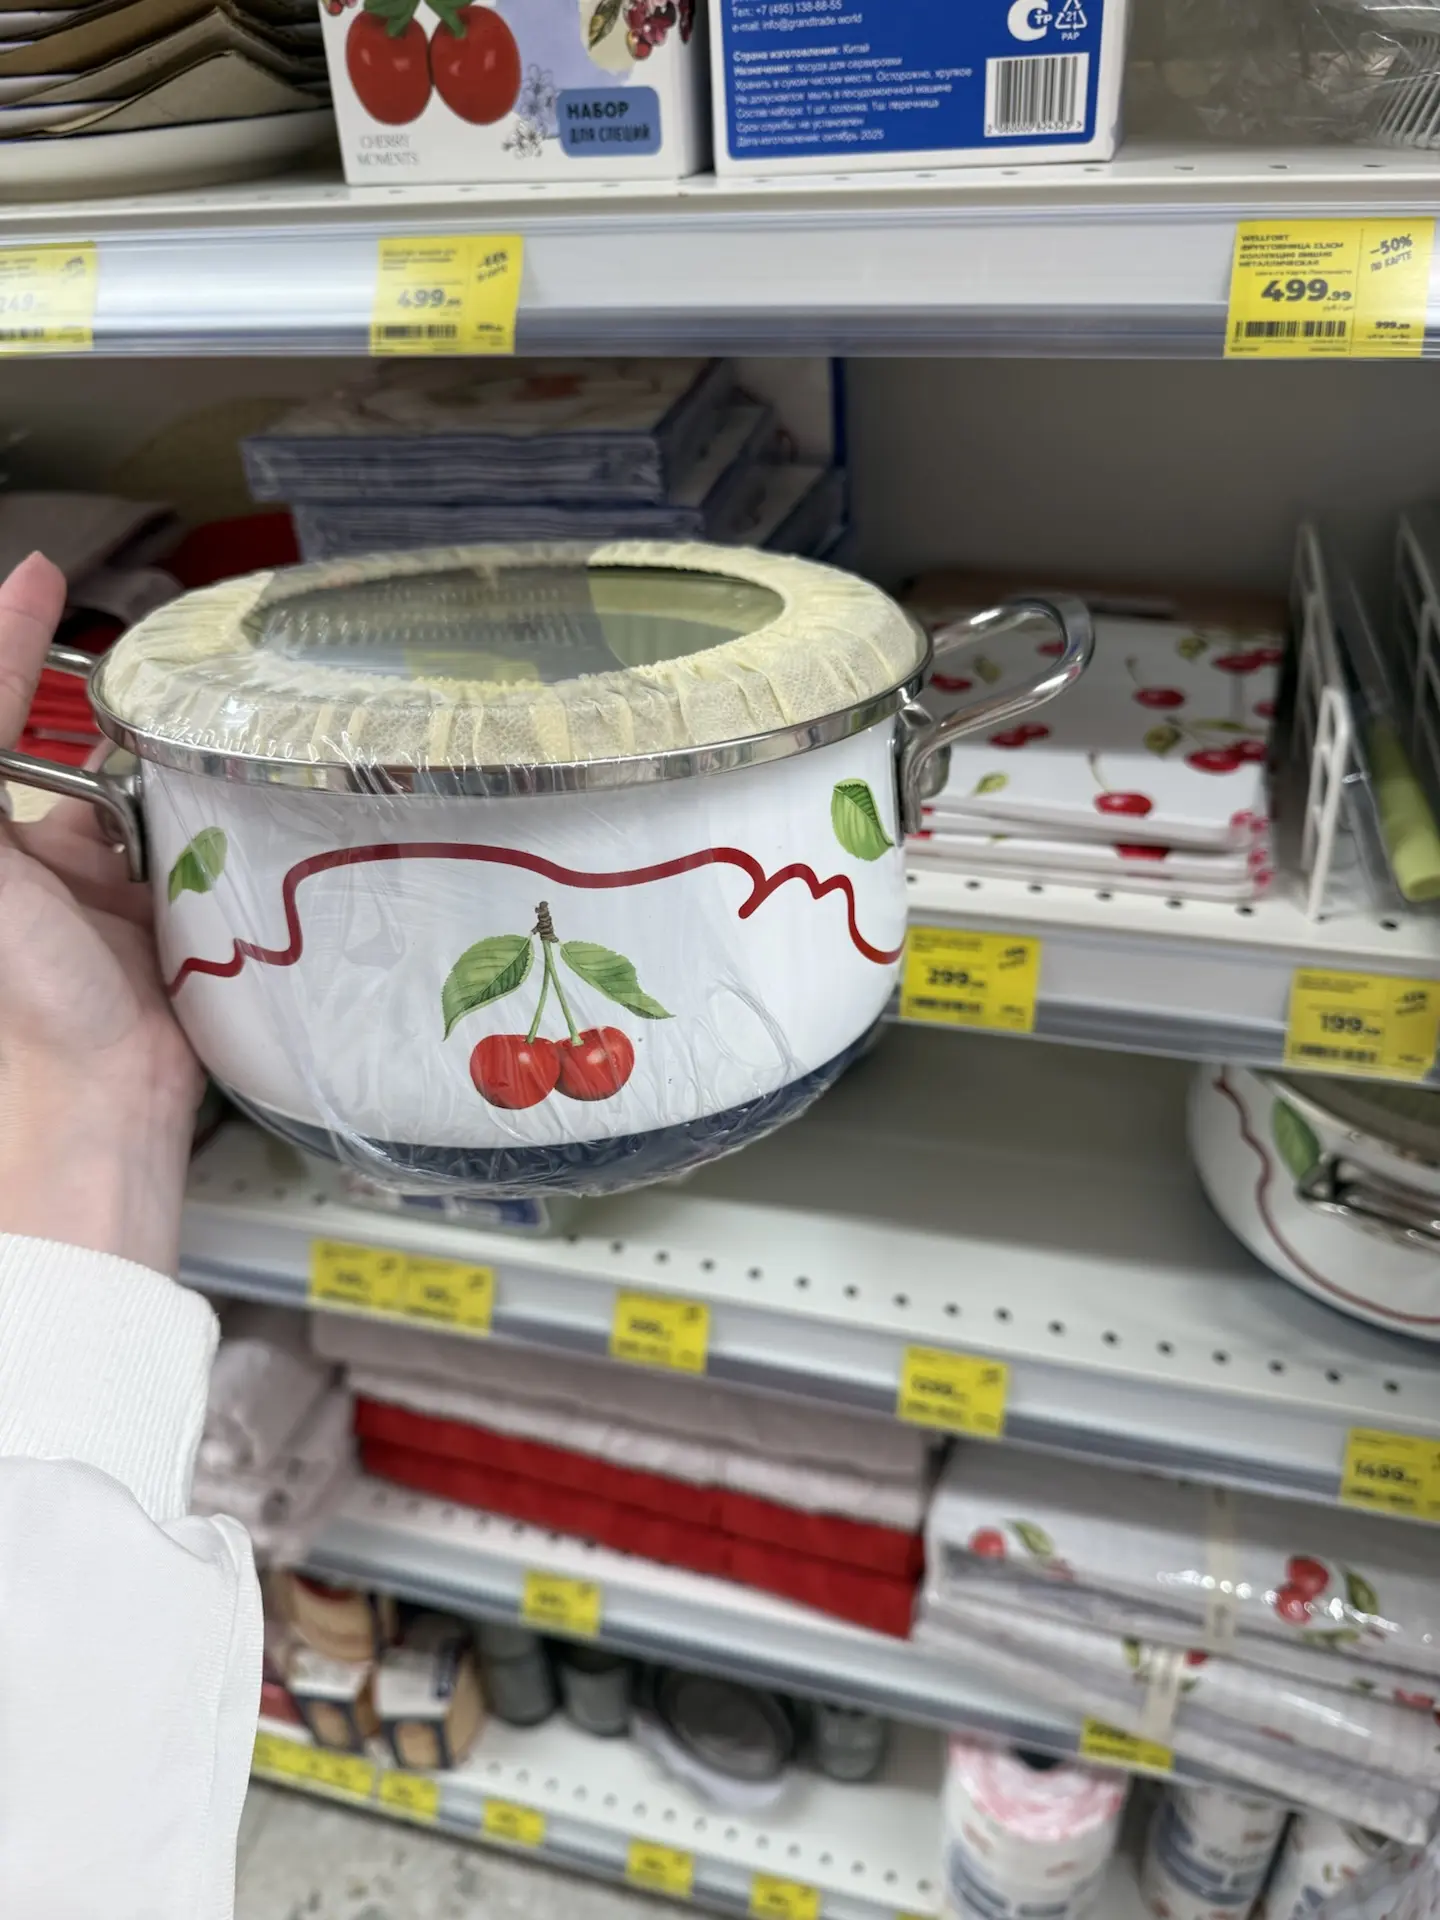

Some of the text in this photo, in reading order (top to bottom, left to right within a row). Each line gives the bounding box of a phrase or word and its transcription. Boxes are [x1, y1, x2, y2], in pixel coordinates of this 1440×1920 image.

[1065, 11, 1078, 22] 21
[1061, 31, 1081, 41] PAP
[565, 101, 631, 120] НАБОР
[570, 122, 651, 145] ДЛЯ СПЕЦИЙ
[1370, 250, 1413, 273] ПО КАРТЕ
